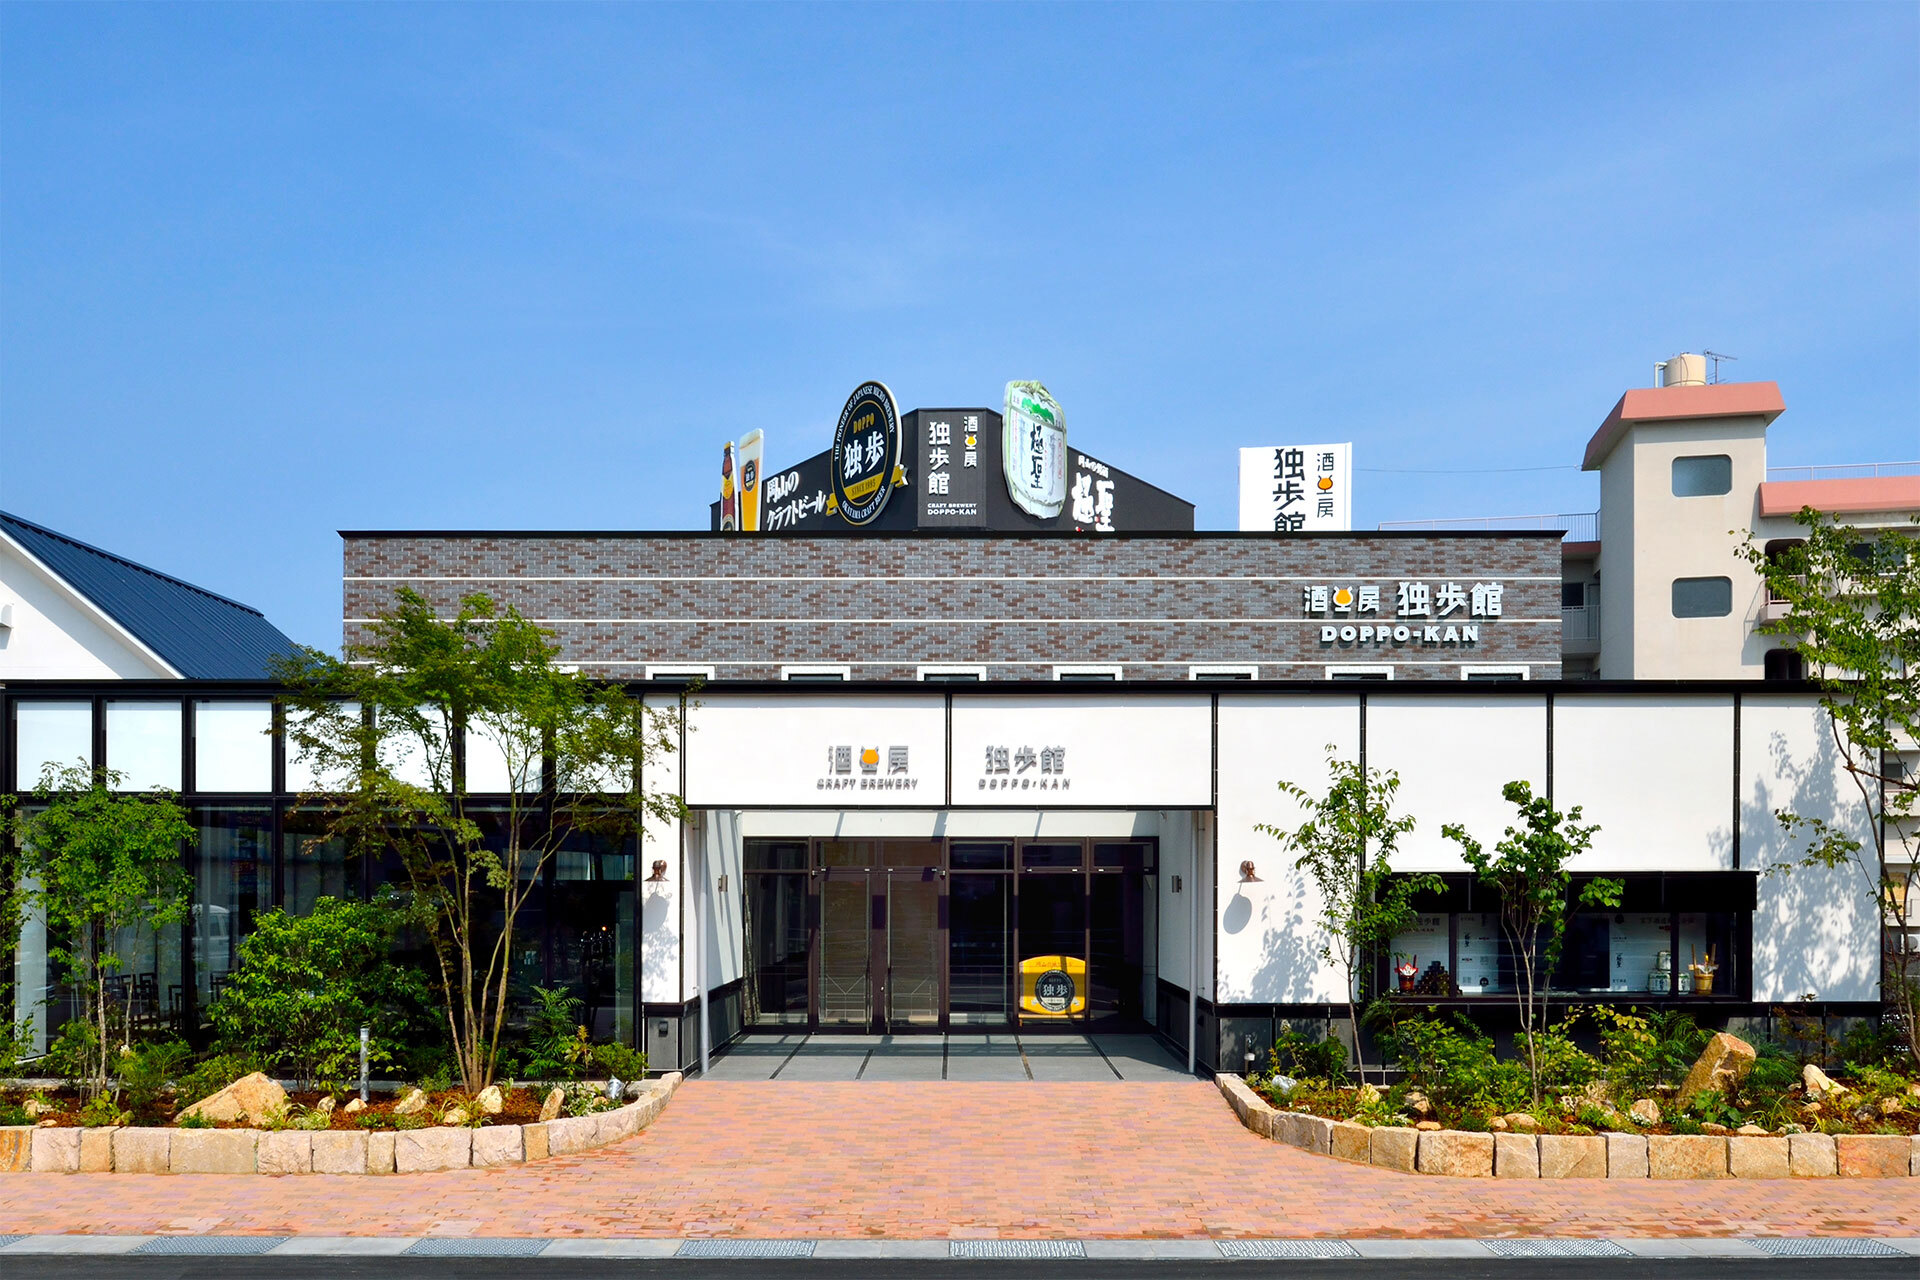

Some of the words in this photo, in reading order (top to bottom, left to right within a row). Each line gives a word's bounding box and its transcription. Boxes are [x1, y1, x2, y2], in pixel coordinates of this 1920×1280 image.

[853, 412, 875, 434] DOPPO
[843, 430, 885, 480] 独歩
[928, 421, 951, 495] 独歩館
[766, 470, 799, 504] 岡山の
[766, 490, 826, 531] クラフトビール
[1398, 581, 1504, 617] 独歩館
[1321, 625, 1479, 643] DOPPO-KAN
[985, 745, 1066, 774] 独歩館
[816, 778, 856, 790] CRAFT
[860, 778, 918, 790] BREWERY
[1043, 983, 1068, 997] 独歩
